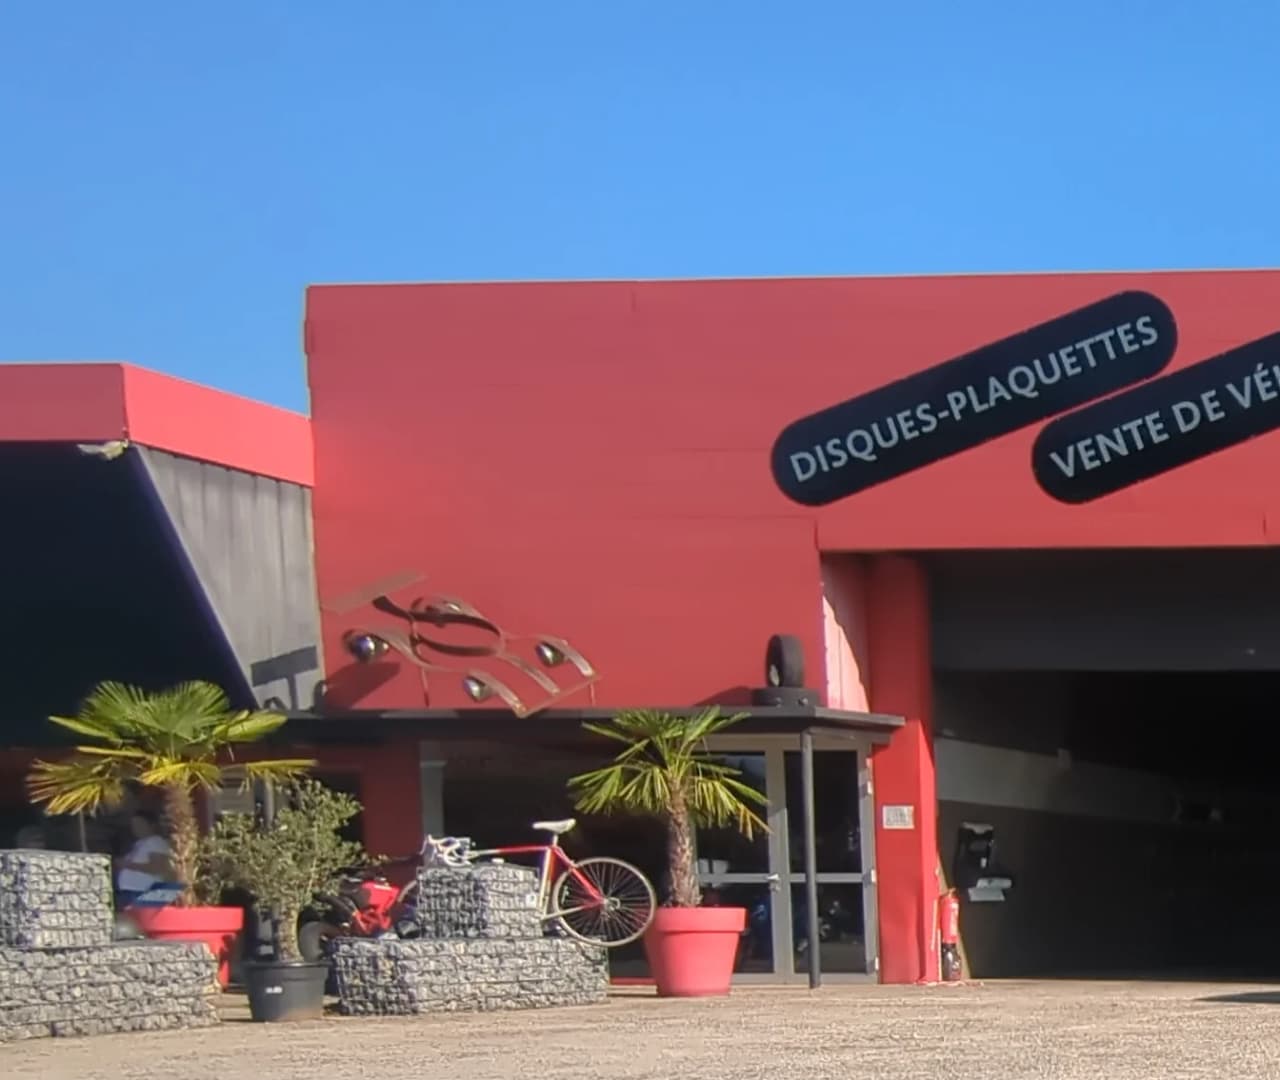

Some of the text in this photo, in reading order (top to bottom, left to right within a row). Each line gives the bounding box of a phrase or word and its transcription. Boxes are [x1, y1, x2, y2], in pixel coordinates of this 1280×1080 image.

[790, 316, 1158, 483] DISQUES-PLAQUETTES
[1049, 411, 1170, 478] VENTE
[1171, 390, 1225, 433] DE
